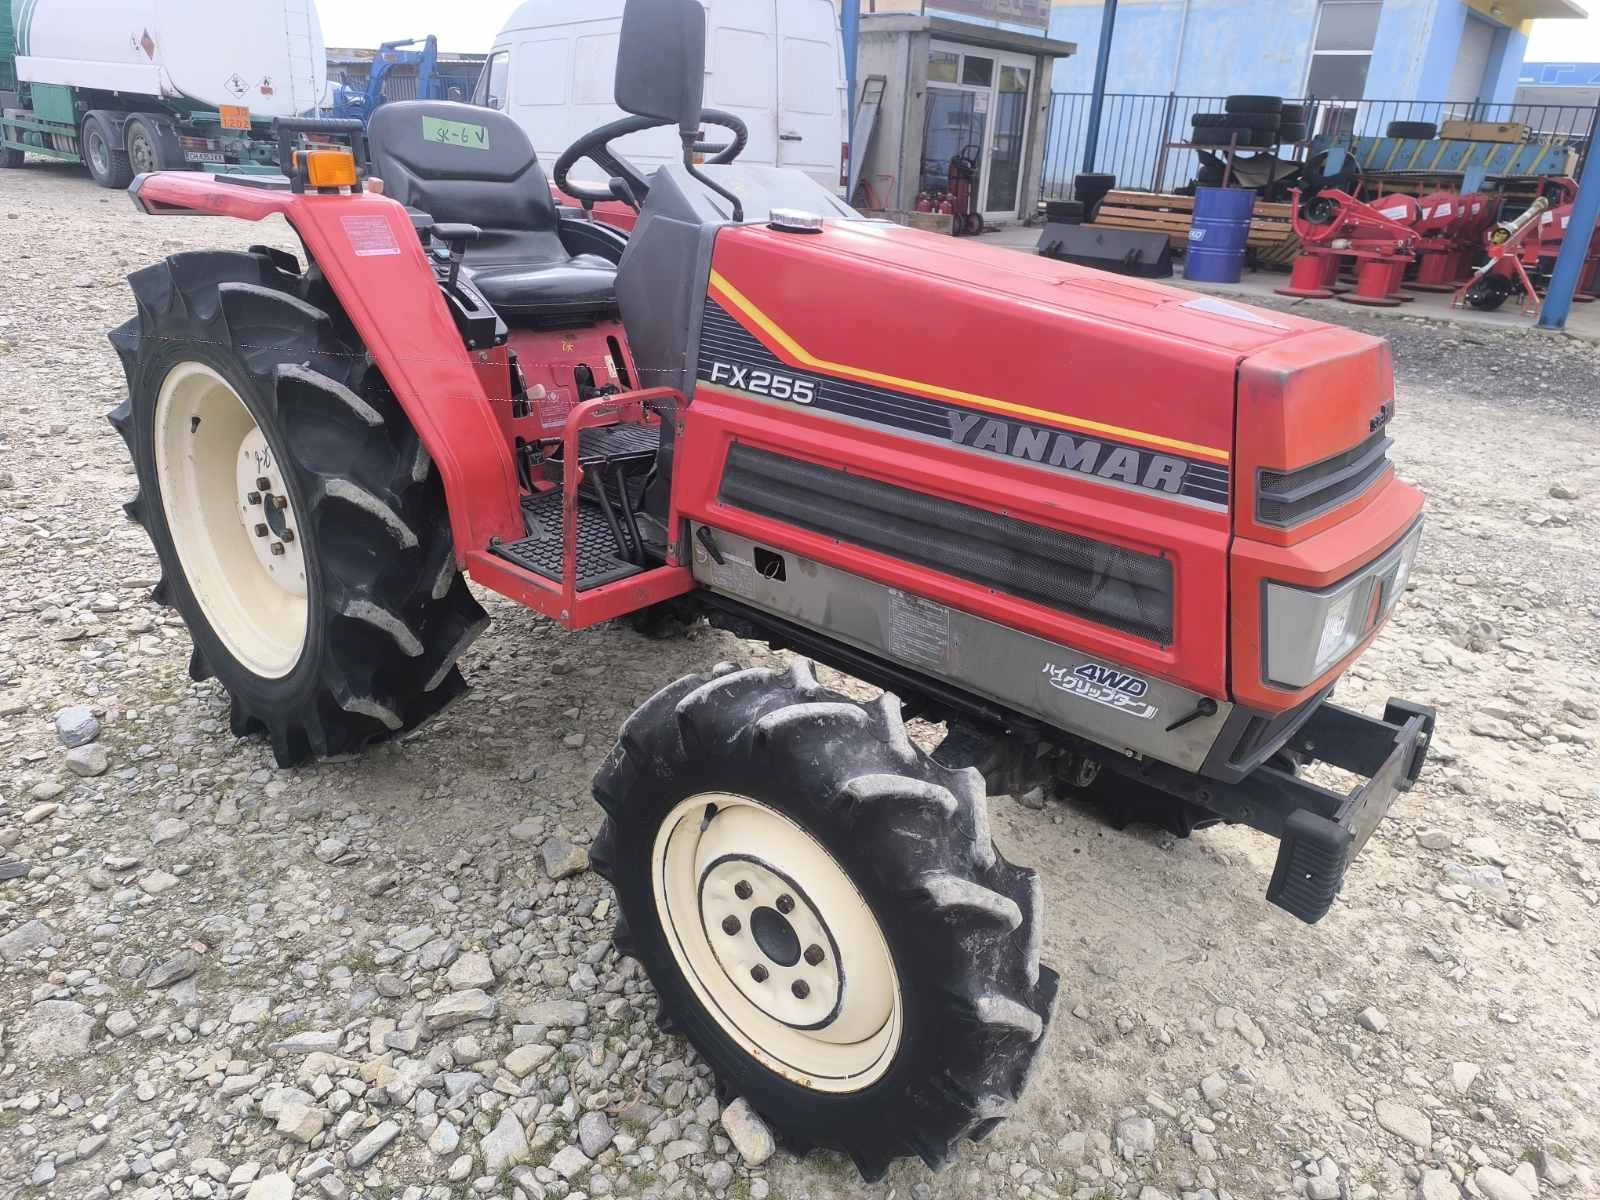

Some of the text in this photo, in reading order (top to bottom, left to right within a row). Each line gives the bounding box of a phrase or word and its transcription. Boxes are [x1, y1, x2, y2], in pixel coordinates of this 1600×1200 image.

[711, 361, 815, 404] FX255
[949, 409, 1188, 495] YANMAR
[1074, 663, 1149, 698] 4WD
